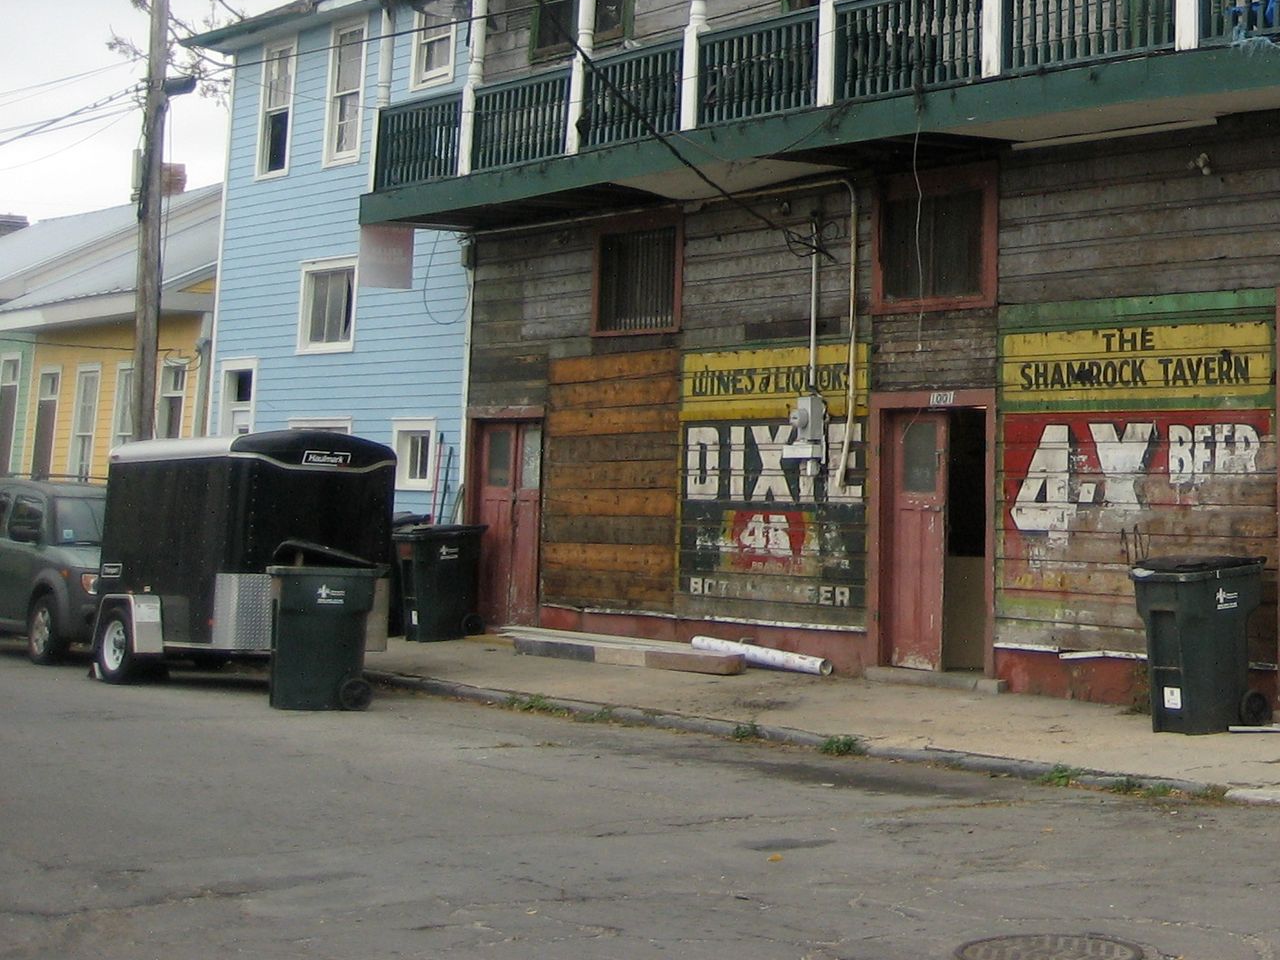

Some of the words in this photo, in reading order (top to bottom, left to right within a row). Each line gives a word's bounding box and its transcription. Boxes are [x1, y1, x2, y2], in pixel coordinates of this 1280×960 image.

[1102, 328, 1156, 353] THE
[693, 365, 755, 396] WINES
[1020, 358, 1147, 390] SHAMROCK
[1158, 352, 1250, 386] TAVERN
[1168, 424, 1260, 484] BEER
